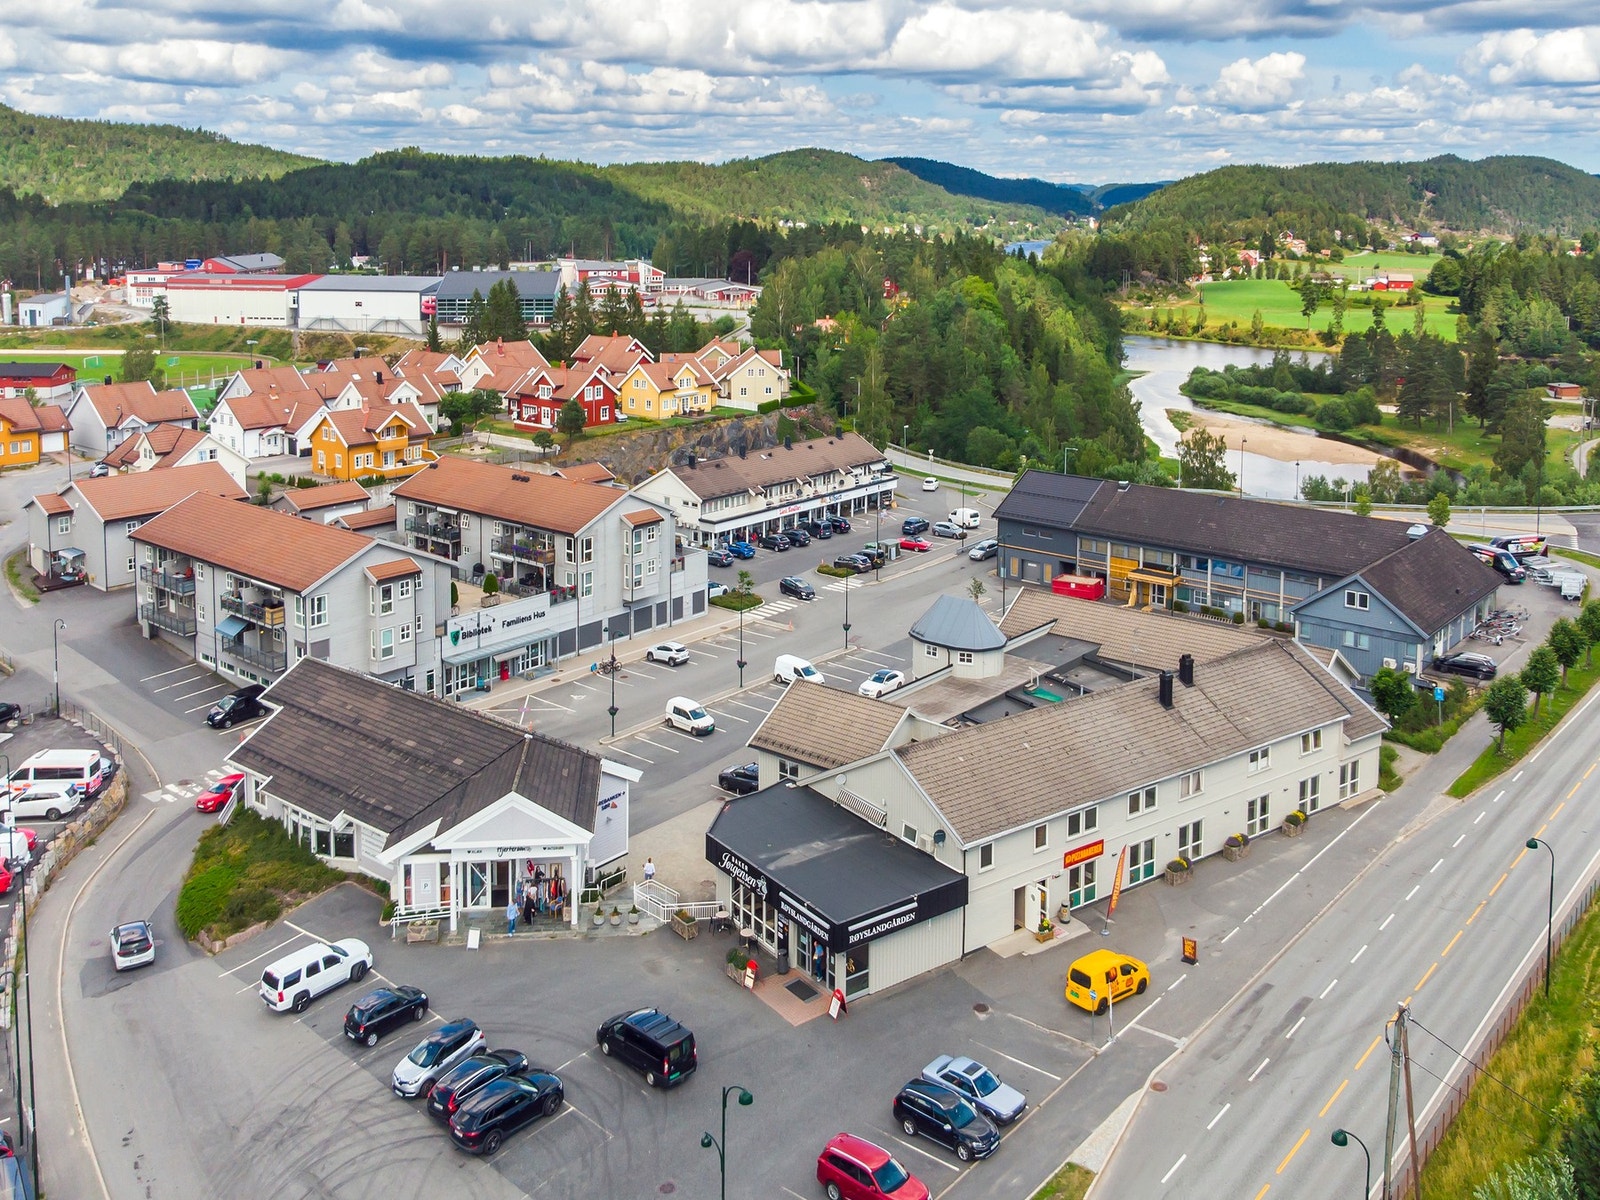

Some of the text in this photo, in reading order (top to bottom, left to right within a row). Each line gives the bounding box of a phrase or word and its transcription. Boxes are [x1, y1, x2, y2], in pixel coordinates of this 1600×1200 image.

[502, 610, 546, 628] Familiens Hus
[461, 625, 492, 640] Bibliotek
[718, 852, 757, 888] Jørgensen
[731, 855, 748, 871] BAKER
[780, 901, 829, 941] RØYSLANDGÅRDEN
[848, 912, 916, 943] RØYSLANDGÅRDEN
